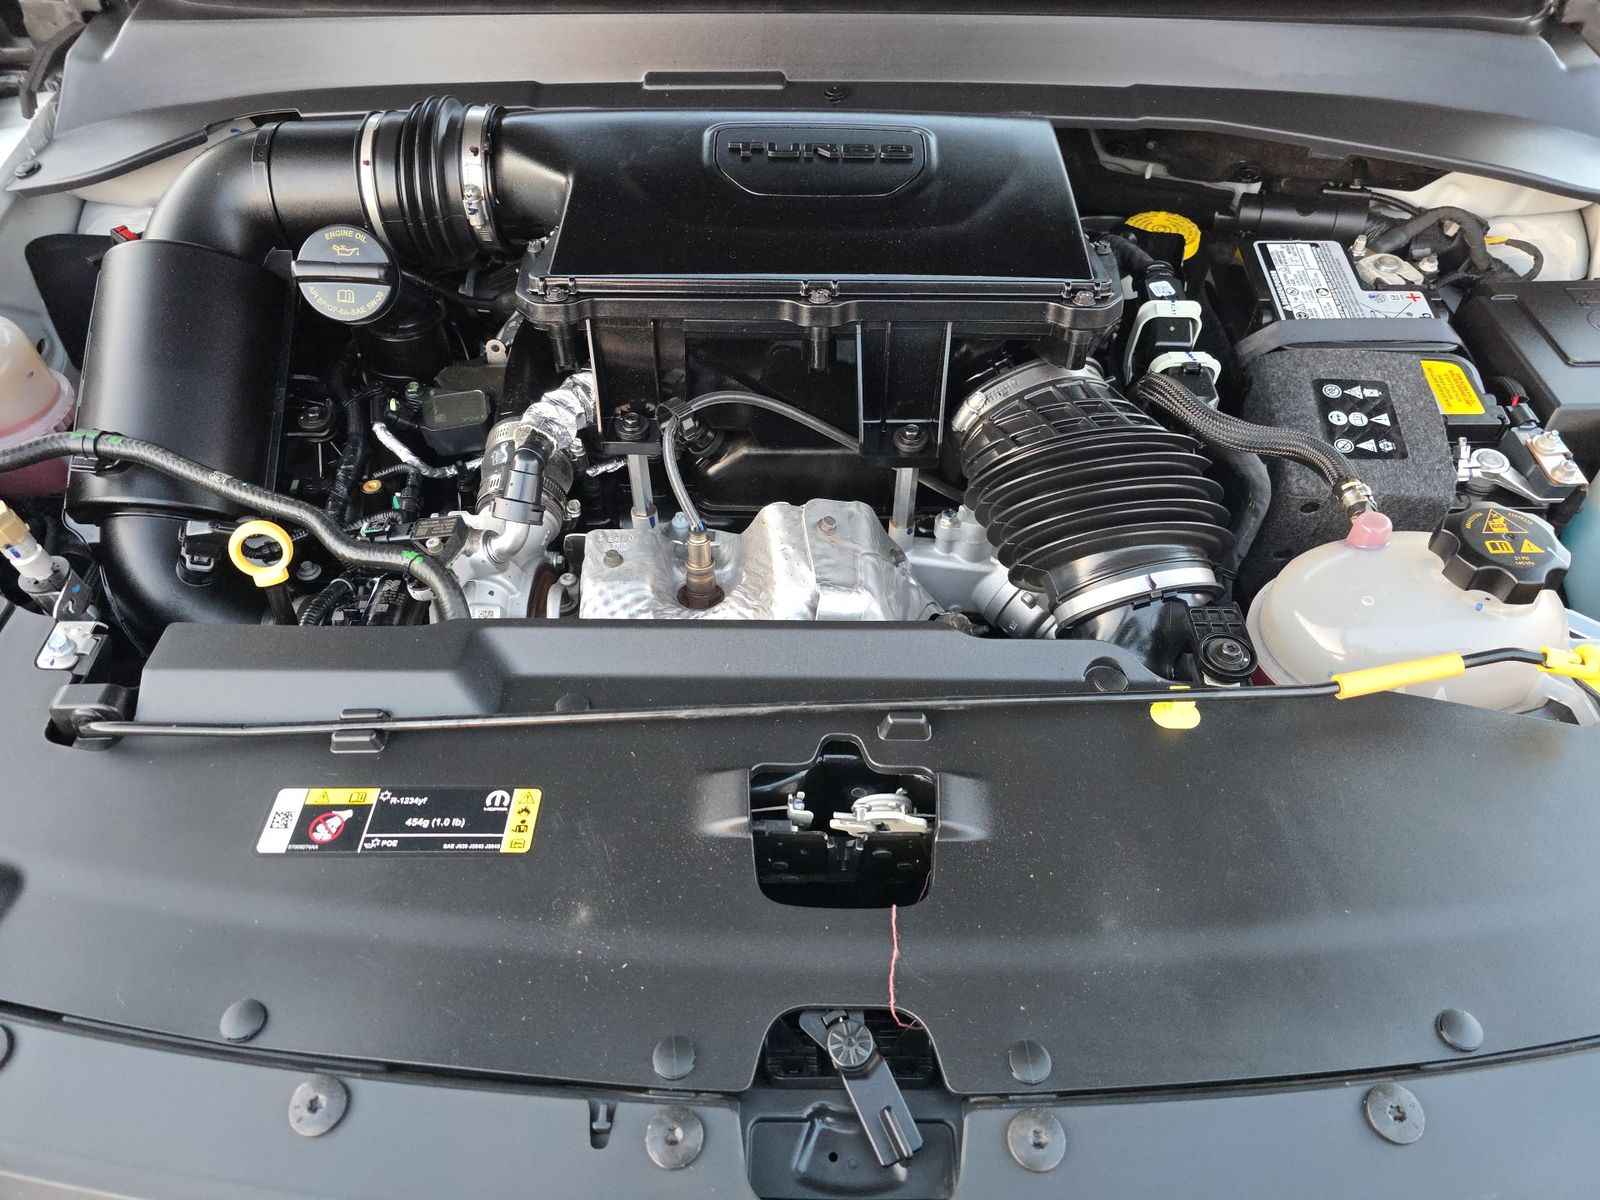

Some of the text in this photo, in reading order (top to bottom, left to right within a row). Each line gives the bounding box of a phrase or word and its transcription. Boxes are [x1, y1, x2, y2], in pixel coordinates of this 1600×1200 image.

[728, 140, 915, 160] TURBO
[324, 230, 367, 243] ENGINE OIL
[390, 797, 428, 806] R-1234yf
[405, 817, 466, 828] 454g (1.0 lb)
[381, 839, 399, 848] POE
